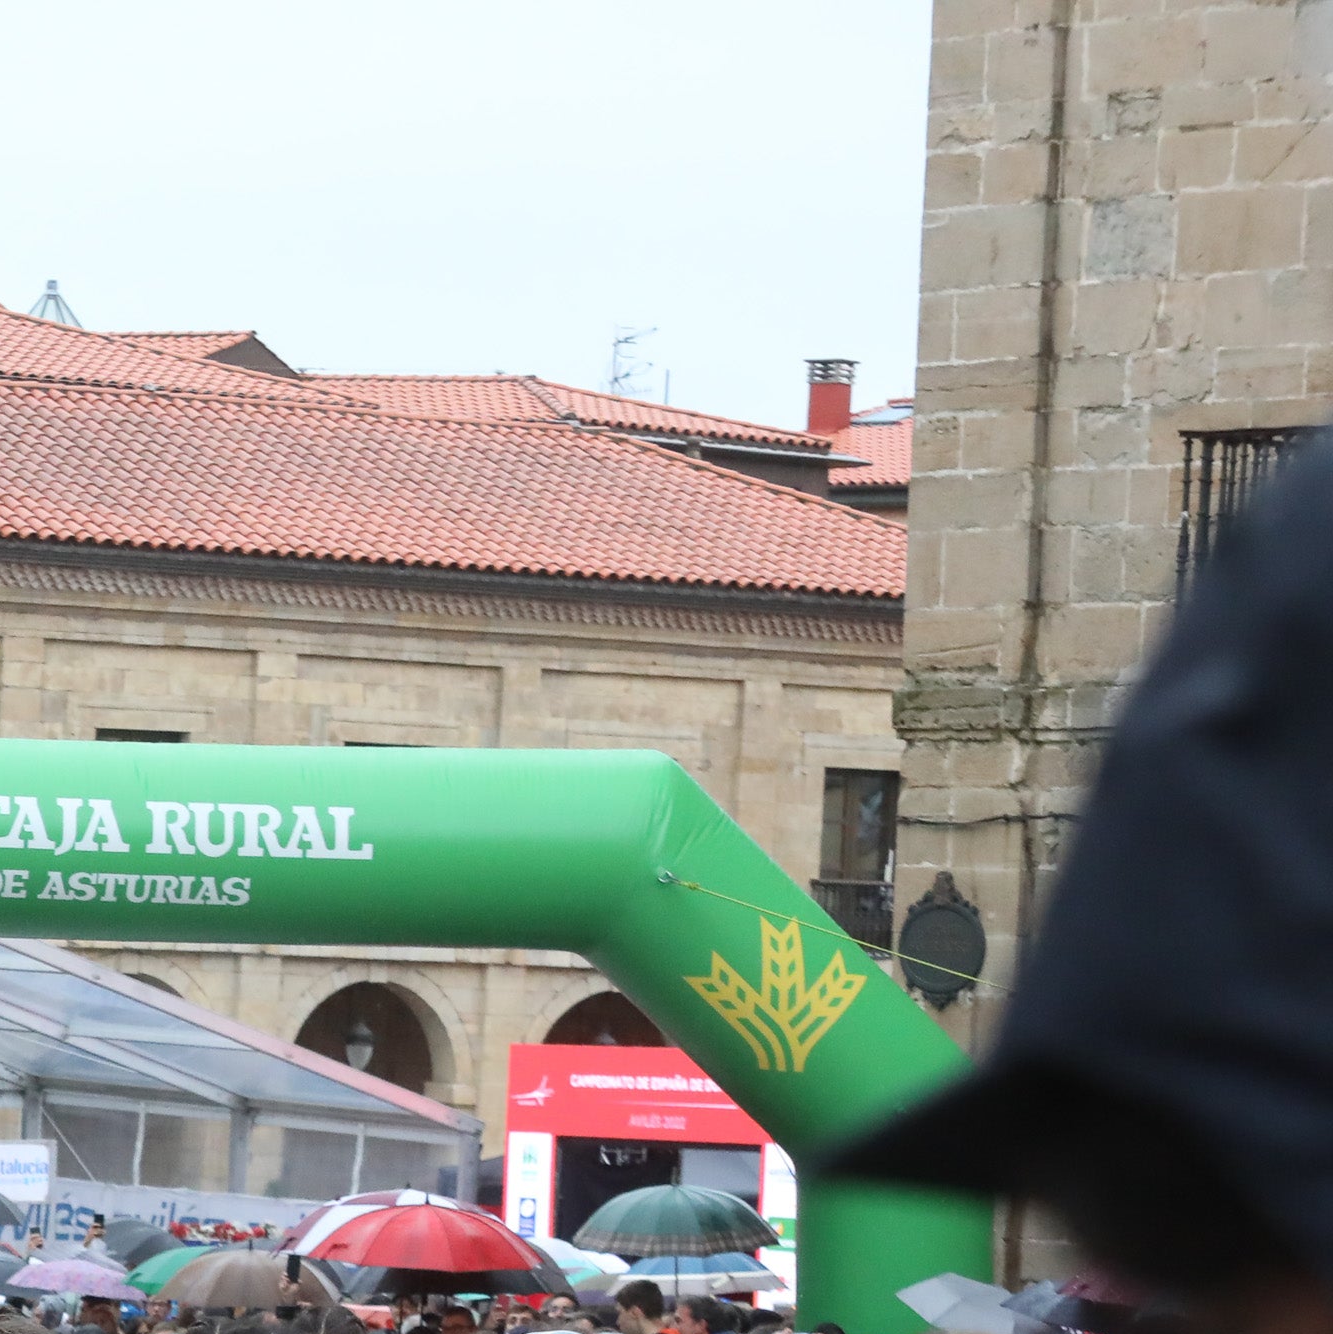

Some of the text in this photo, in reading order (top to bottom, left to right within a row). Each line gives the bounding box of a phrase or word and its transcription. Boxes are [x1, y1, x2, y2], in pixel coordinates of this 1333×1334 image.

[145, 800, 374, 860] RURAL
[37, 870, 252, 907] ASTURIAS
[570, 1073, 633, 1089] CAMPEONATO
[635, 1076, 649, 1090] DE
[651, 1074, 689, 1092] ESPAÑA
[690, 1078, 704, 1092] DE
